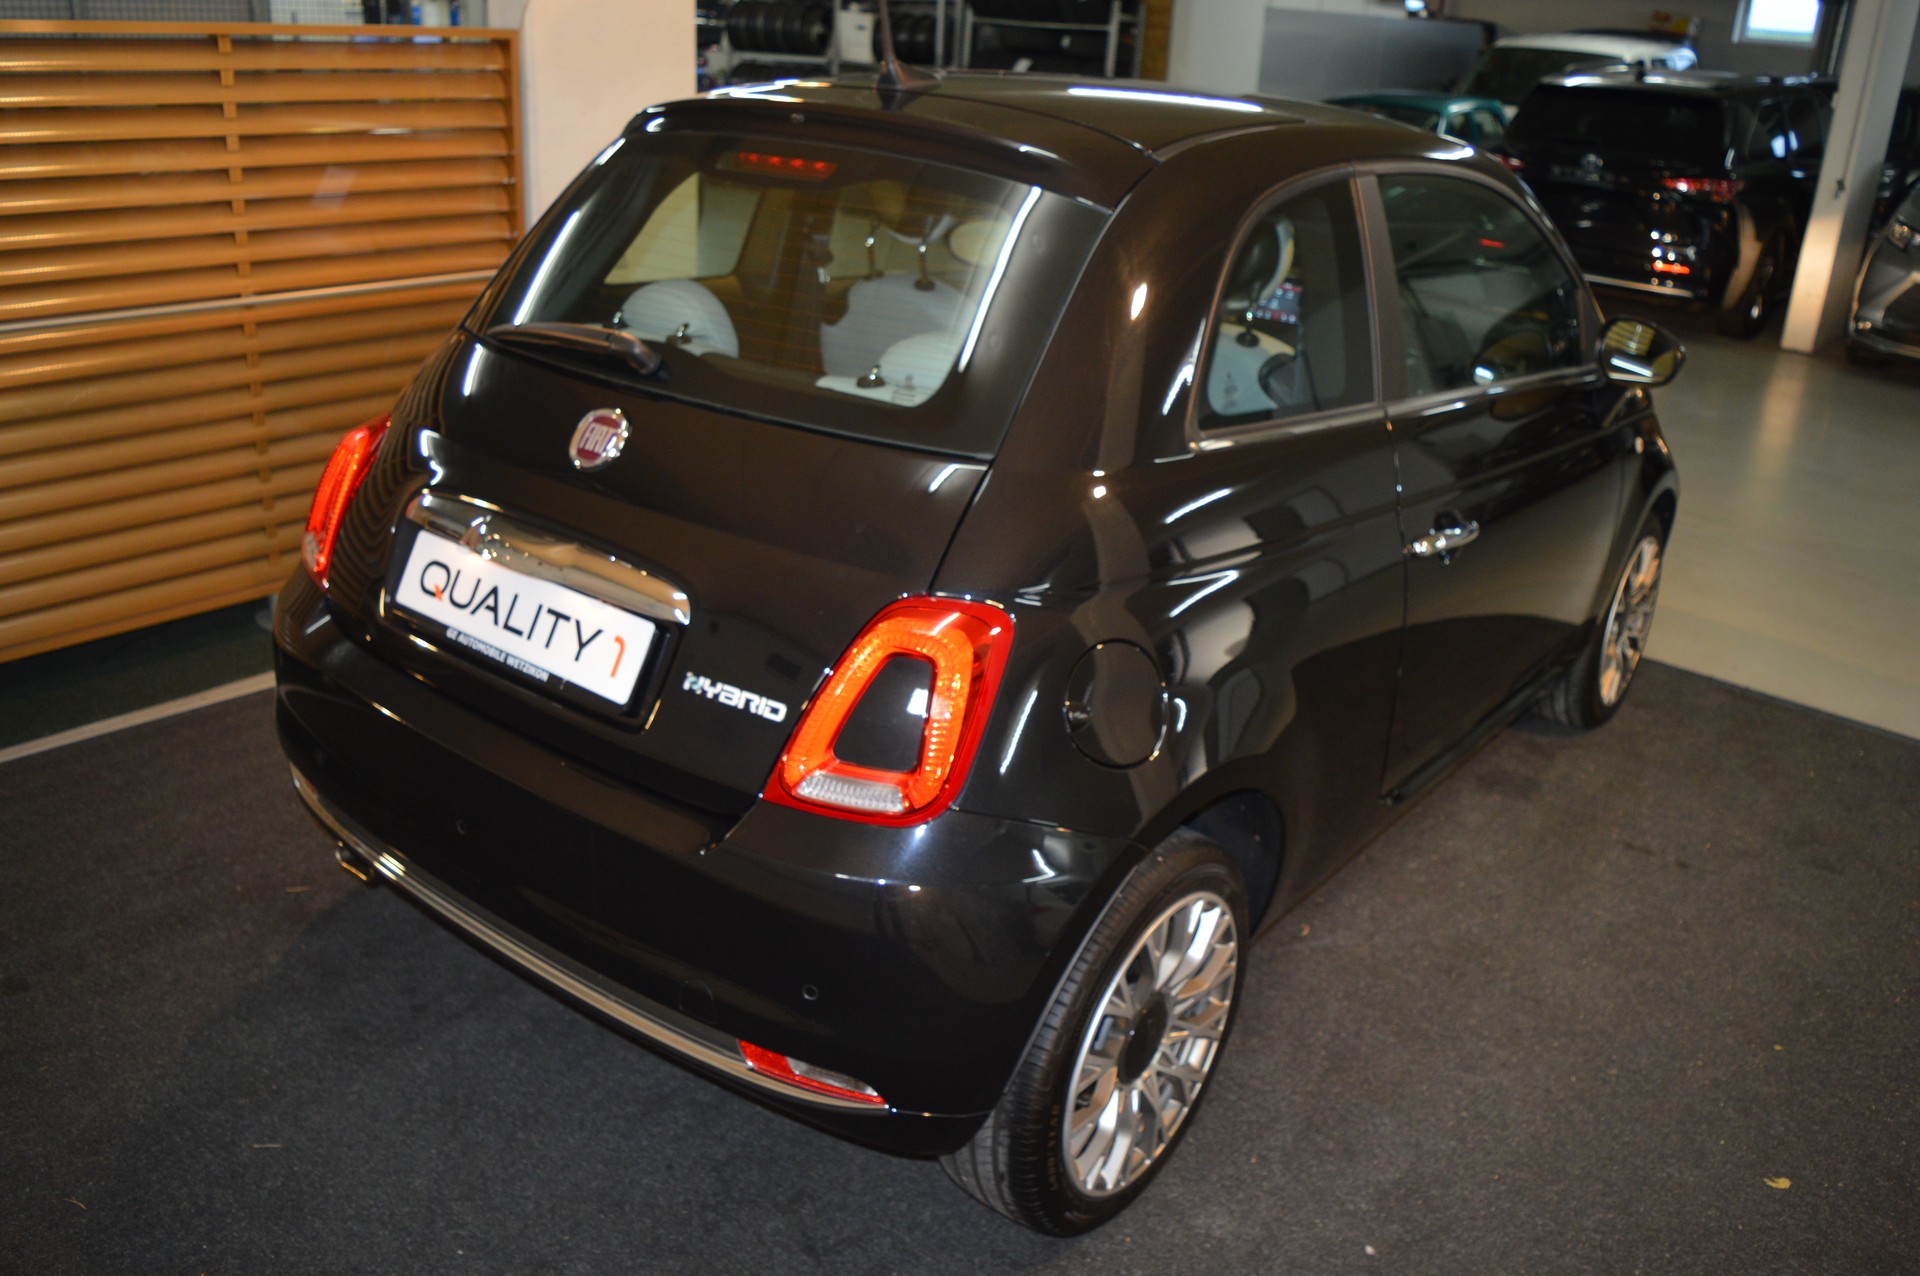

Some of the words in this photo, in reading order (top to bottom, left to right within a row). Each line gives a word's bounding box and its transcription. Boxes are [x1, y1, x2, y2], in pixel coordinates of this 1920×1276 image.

[419, 560, 604, 662] QUALITY
[611, 635, 626, 679] 1
[457, 631, 507, 663] AUTOMOBILE
[506, 654, 550, 683] WETZIKON
[682, 671, 788, 723] HYBRID
